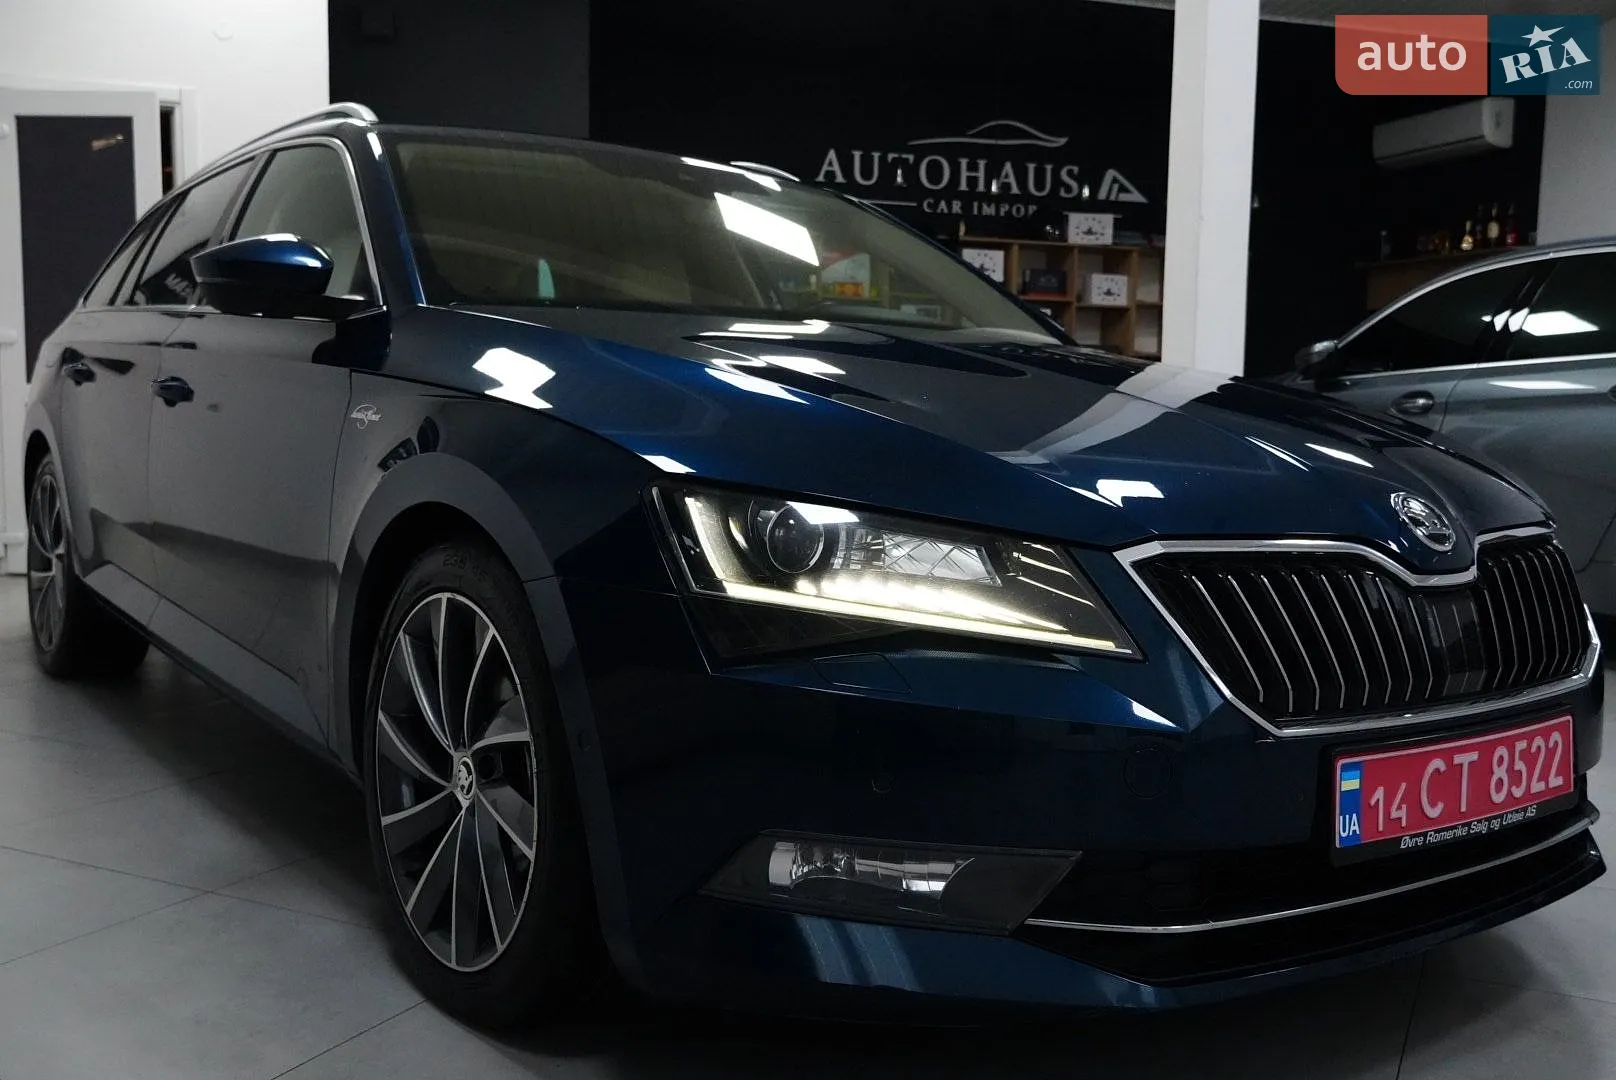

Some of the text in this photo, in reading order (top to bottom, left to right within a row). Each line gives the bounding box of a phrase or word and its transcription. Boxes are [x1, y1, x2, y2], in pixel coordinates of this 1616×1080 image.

[815, 148, 1081, 199] AUTOHAUS
[922, 198, 963, 214] CAR
[1369, 731, 1564, 832] 14 CT 8522
[1339, 813, 1360, 838] UA
[1400, 836, 1424, 849] Øvre
[1426, 825, 1468, 844] Romerike
[1490, 818, 1501, 830] og
[1525, 804, 1537, 817] AS
